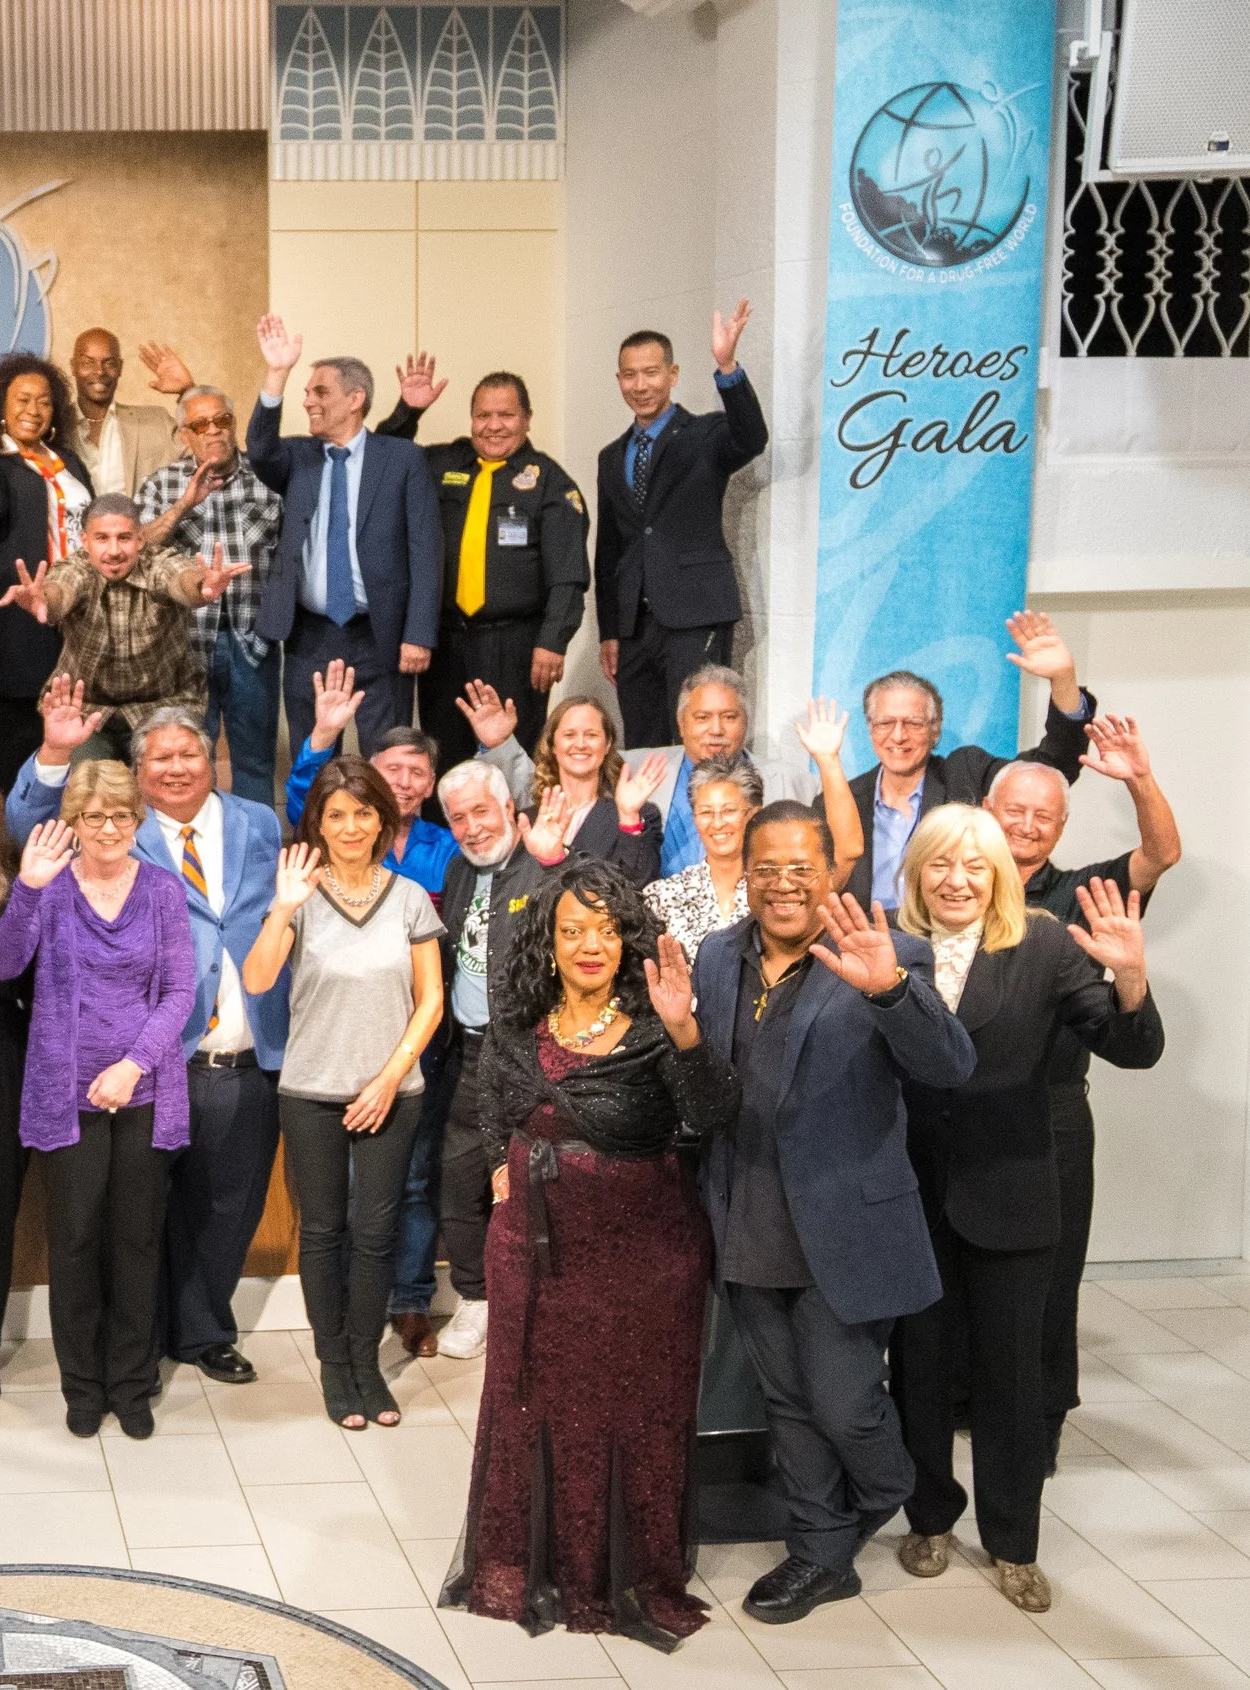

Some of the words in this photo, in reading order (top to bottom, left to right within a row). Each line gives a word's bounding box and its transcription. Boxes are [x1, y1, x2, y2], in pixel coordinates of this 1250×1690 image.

[838, 202, 898, 275] FOUNDATION
[899, 266, 925, 282] FOR
[927, 273, 937, 283] A
[940, 247, 1008, 284] DRUG-FREE
[1004, 203, 1038, 251] WORLD
[830, 327, 1029, 387] Heroes
[837, 390, 1029, 489] Gala
